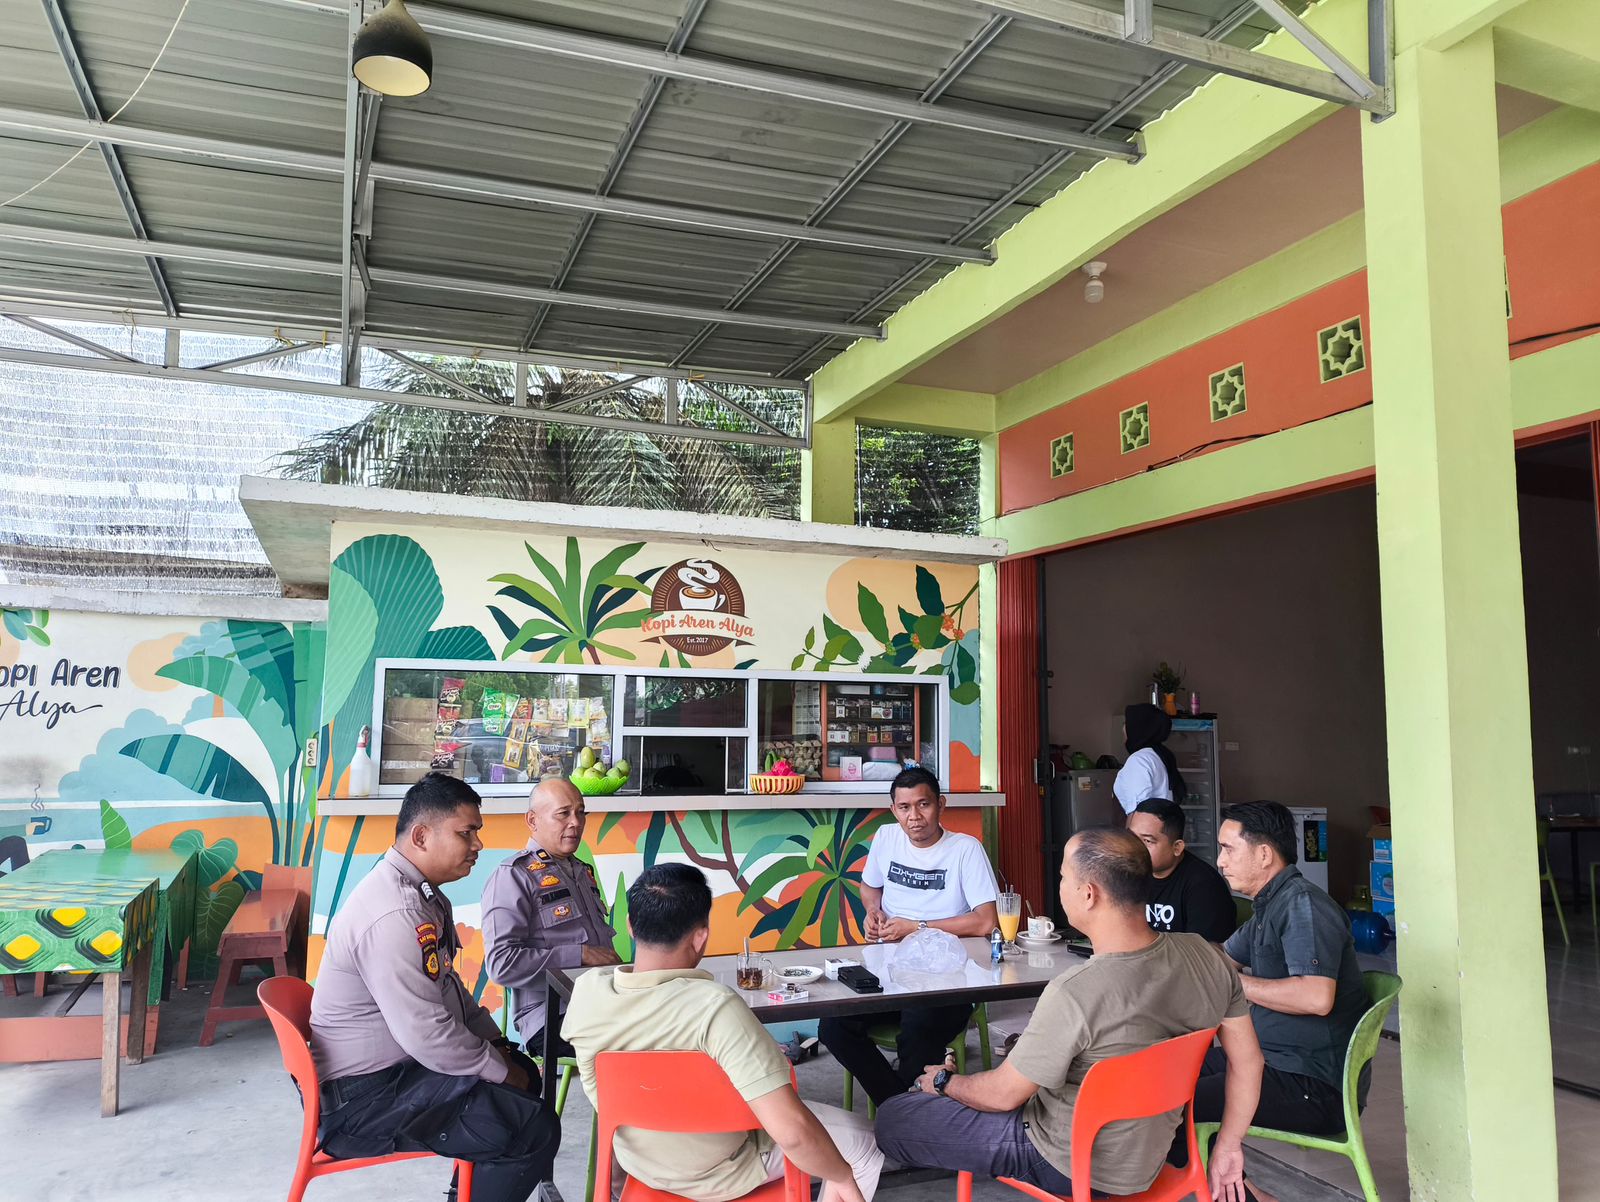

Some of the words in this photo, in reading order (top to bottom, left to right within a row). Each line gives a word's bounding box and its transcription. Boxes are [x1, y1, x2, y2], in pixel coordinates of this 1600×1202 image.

[641, 614, 677, 633] Kopi
[679, 614, 717, 629] Aren
[718, 617, 755, 638] Alya
[51, 658, 121, 688] Aren
[0, 689, 103, 730] Alya
